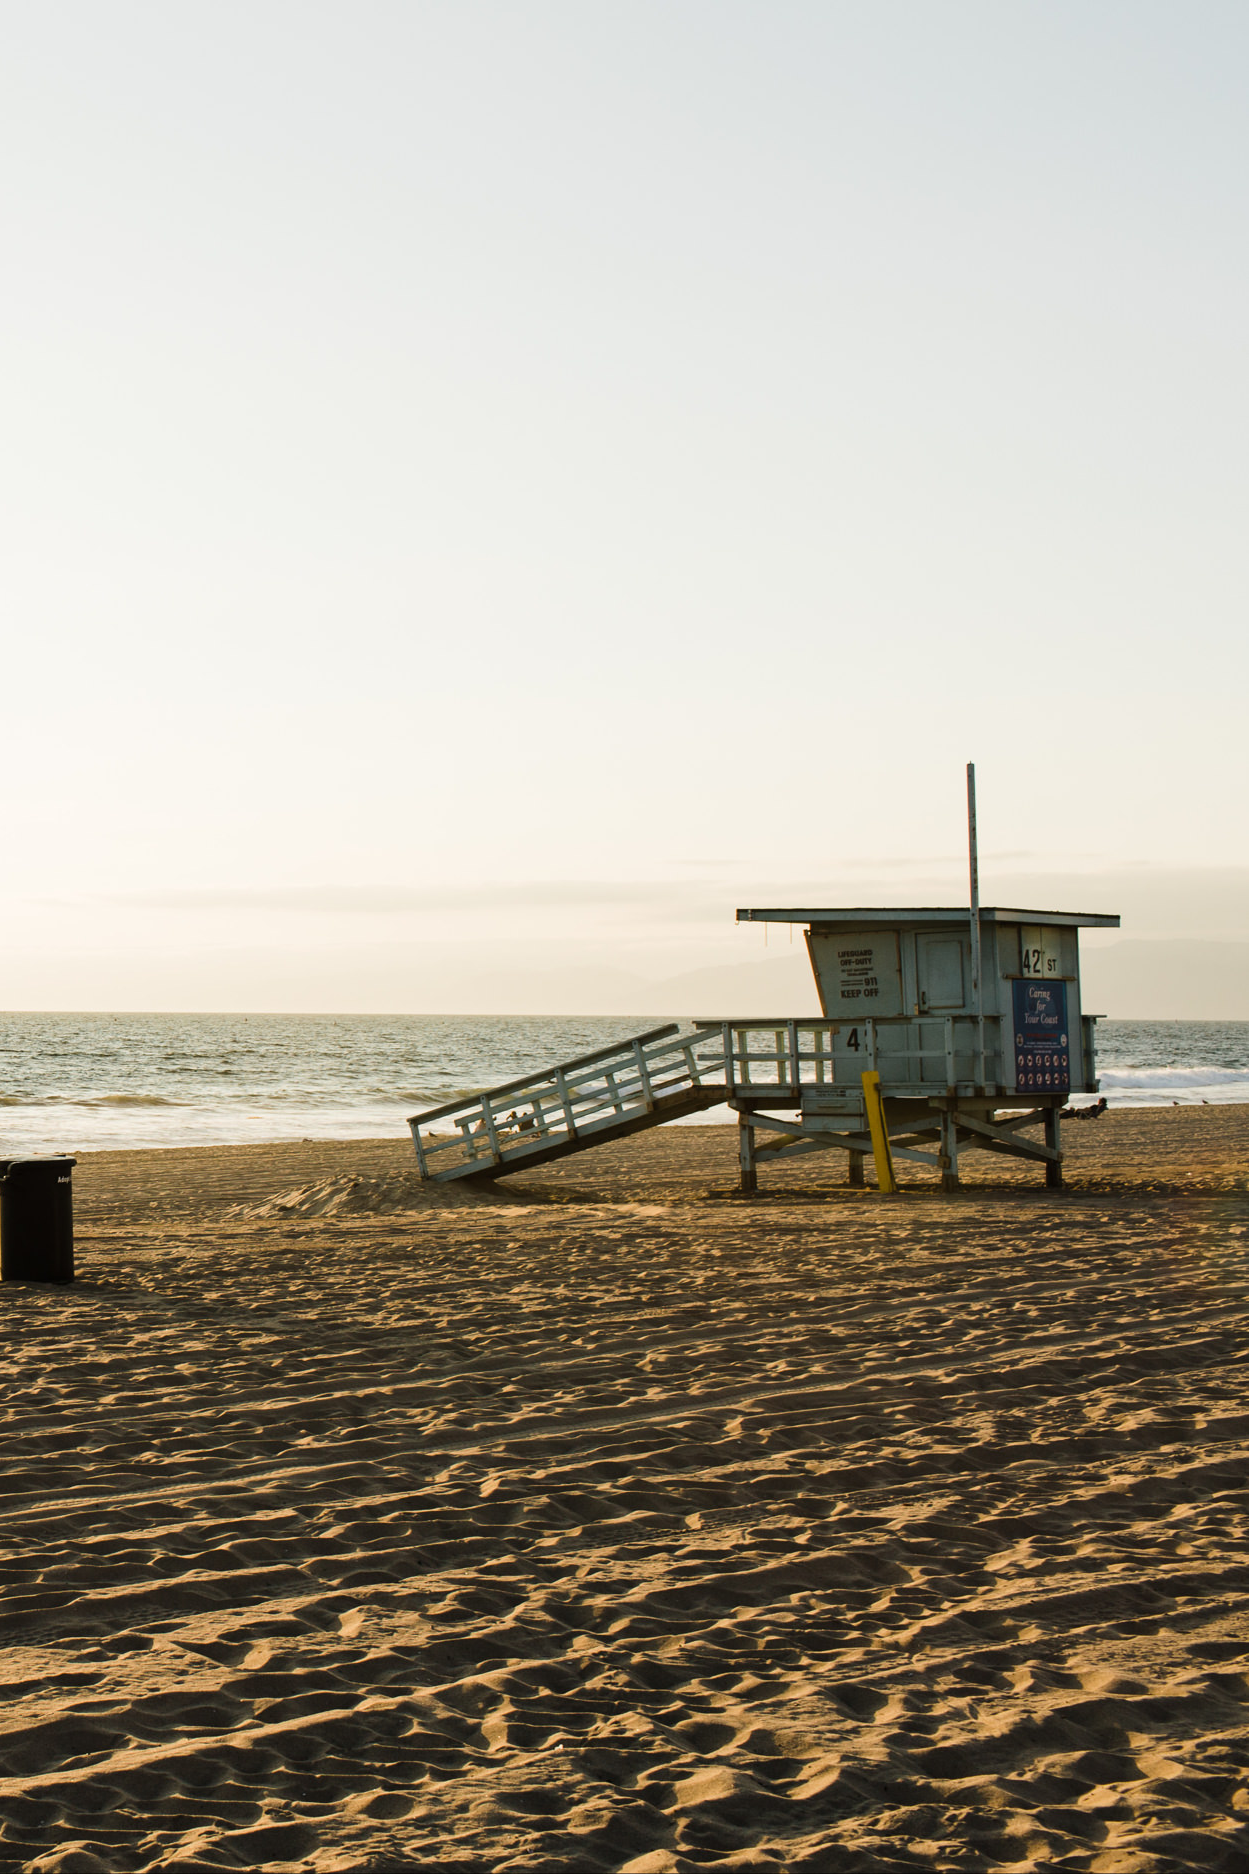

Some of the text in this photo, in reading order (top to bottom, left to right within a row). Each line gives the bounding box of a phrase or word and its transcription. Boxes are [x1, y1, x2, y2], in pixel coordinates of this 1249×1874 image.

[838, 949, 873, 958] LIFEGUARD
[840, 958, 872, 966] OFF-DUTY
[1023, 949, 1057, 974] 42 ST
[864, 977, 878, 986] 911
[841, 988, 879, 998] KEEP OFF
[1029, 987, 1051, 1000] Caring
[1036, 1000, 1046, 1013] for
[1024, 1013, 1059, 1025] Your Coast
